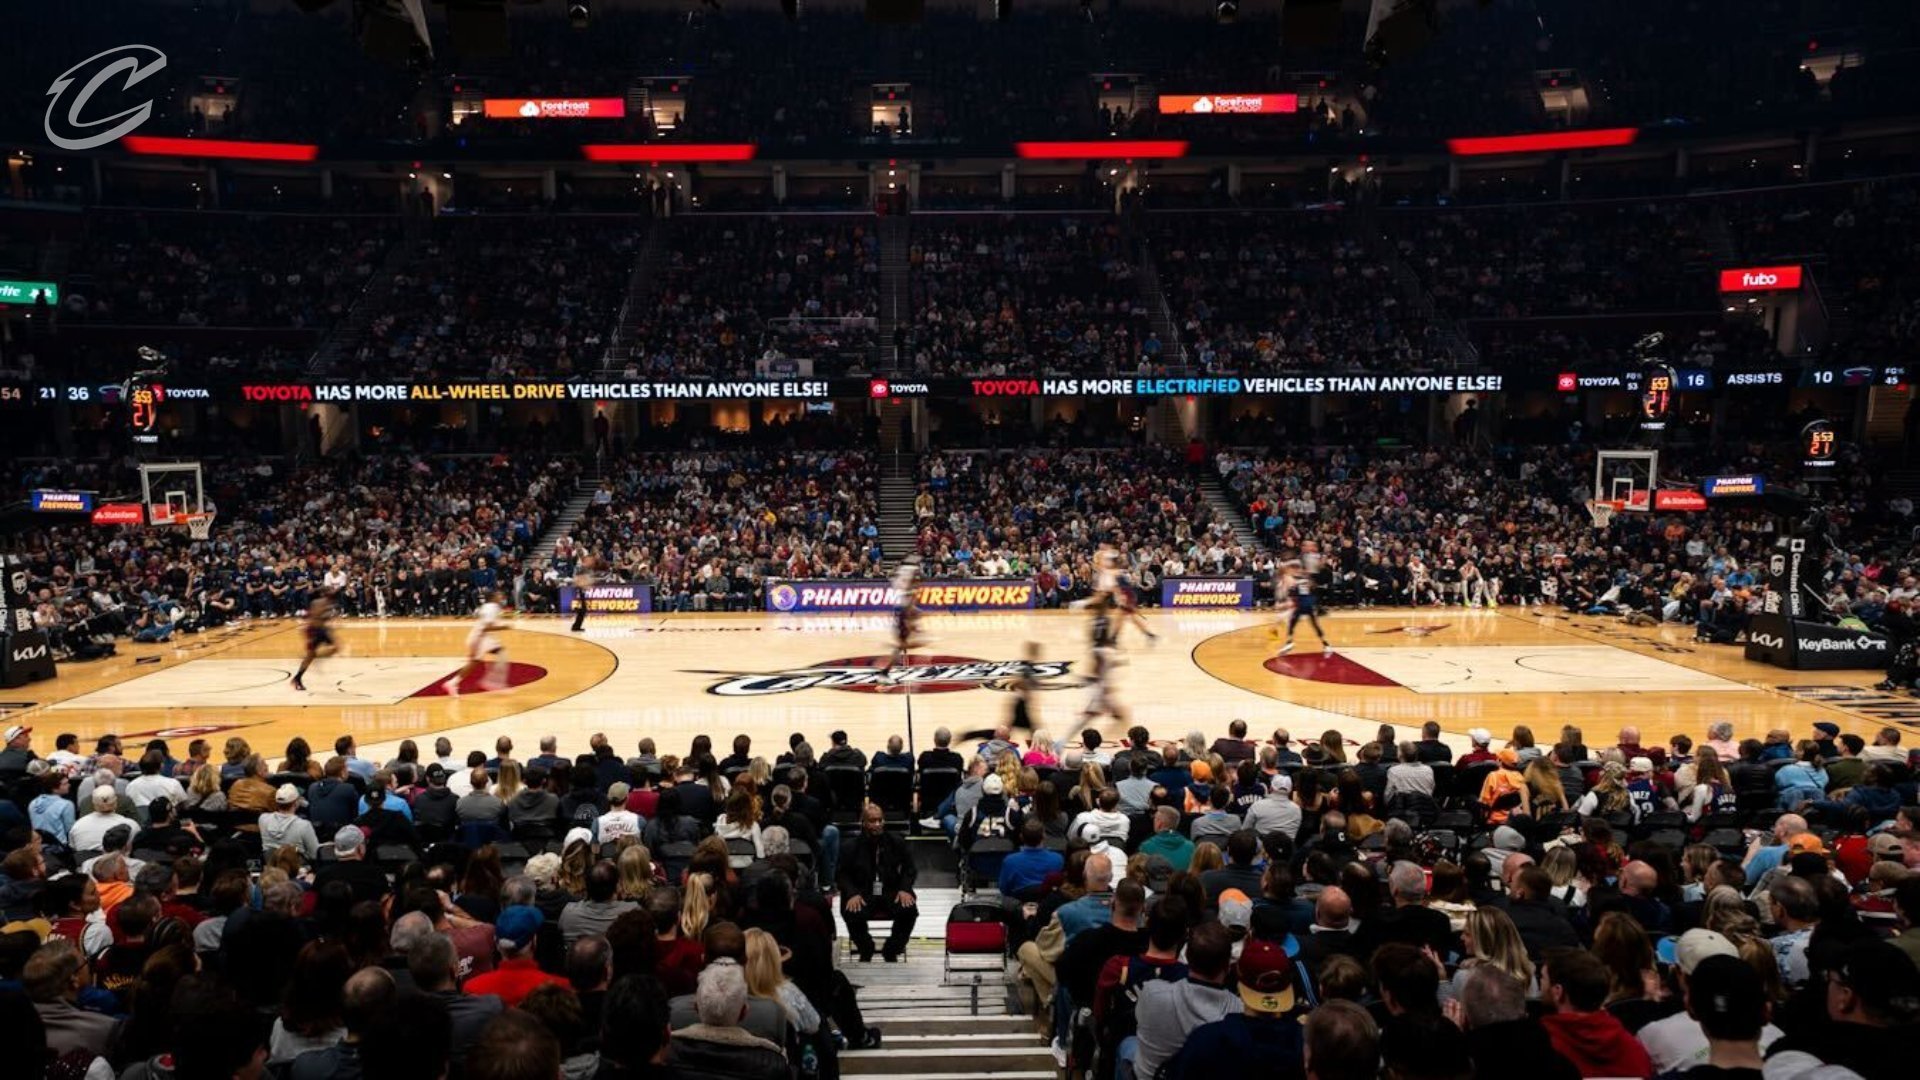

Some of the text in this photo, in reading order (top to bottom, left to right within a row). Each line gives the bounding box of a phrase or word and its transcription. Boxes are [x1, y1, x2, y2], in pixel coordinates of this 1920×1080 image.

[541, 101, 589, 111] ForeFront
[1214, 97, 1262, 107] ForeFront
[1743, 272, 1777, 287] fubo
[1578, 377, 1620, 386] TOYOTA
[1688, 375, 1704, 386] 16
[1727, 373, 1783, 384] ASSISTS
[1814, 371, 1833, 383] 10
[1885, 376, 1899, 385] 45
[242, 382, 828, 400] TOYOTA HAS MORE ALL-WHEEL DRIVE VEHICLES THAN ANYONE ELSE!
[890, 384, 928, 393] TOYOTA
[972, 376, 1502, 396] TOYOTA HAS MORE ELECTRIFIED VEHICLES THAN ANYONE ELSE!
[40, 387, 56, 398] 21
[68, 387, 89, 400] 36
[166, 389, 209, 398] TOYOTA
[1811, 442, 1829, 455] 21
[1179, 582, 1236, 592] PHANTOM
[1173, 593, 1241, 605] FIREWORKS
[1798, 638, 1856, 652] KeyBank
